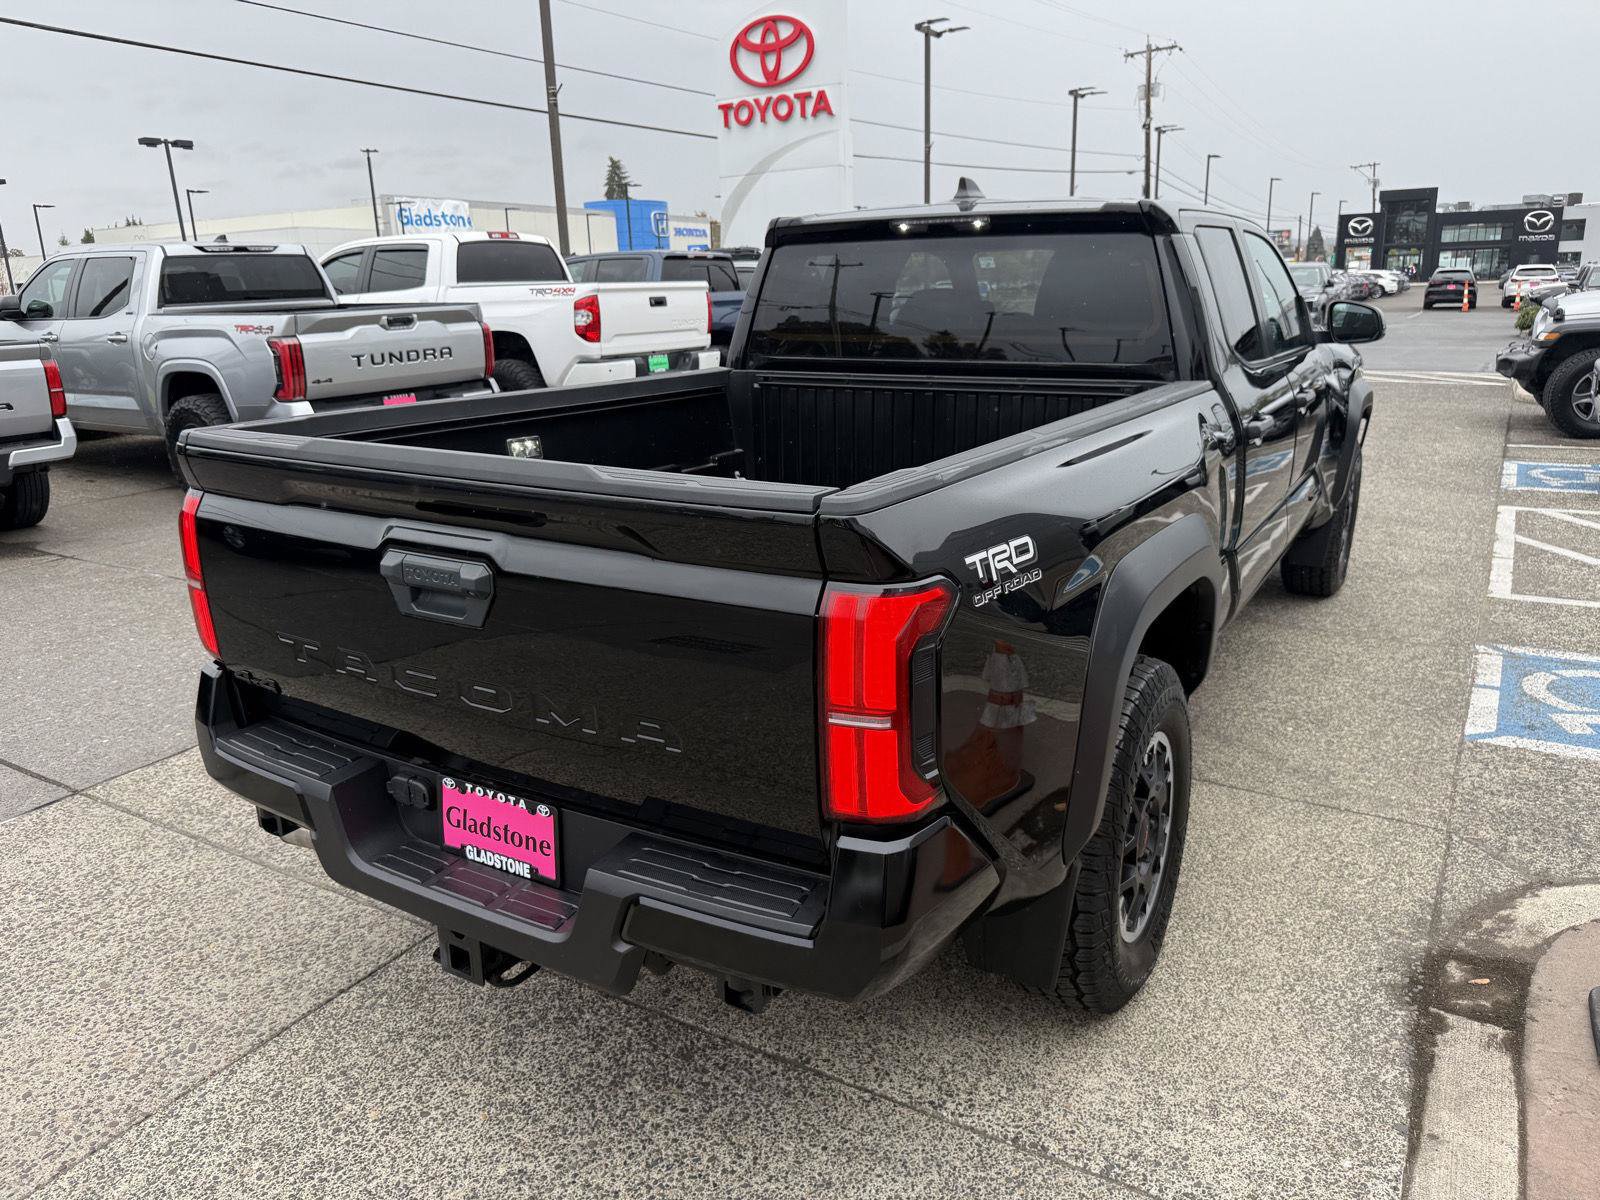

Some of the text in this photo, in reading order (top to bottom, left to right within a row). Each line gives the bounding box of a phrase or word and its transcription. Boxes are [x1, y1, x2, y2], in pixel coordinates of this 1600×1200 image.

[718, 90, 834, 128] TOYOTA
[673, 227, 708, 237] HONDA
[351, 346, 453, 368] TUNDRA
[964, 535, 1036, 582] TRD
[404, 567, 459, 587] TOYOTA
[972, 567, 1043, 608] OFF ROAD
[275, 630, 683, 754] TACOMA
[464, 783, 527, 810] TOYOTA
[445, 805, 552, 857] Gladstone
[465, 844, 532, 879] GLADSTONE
